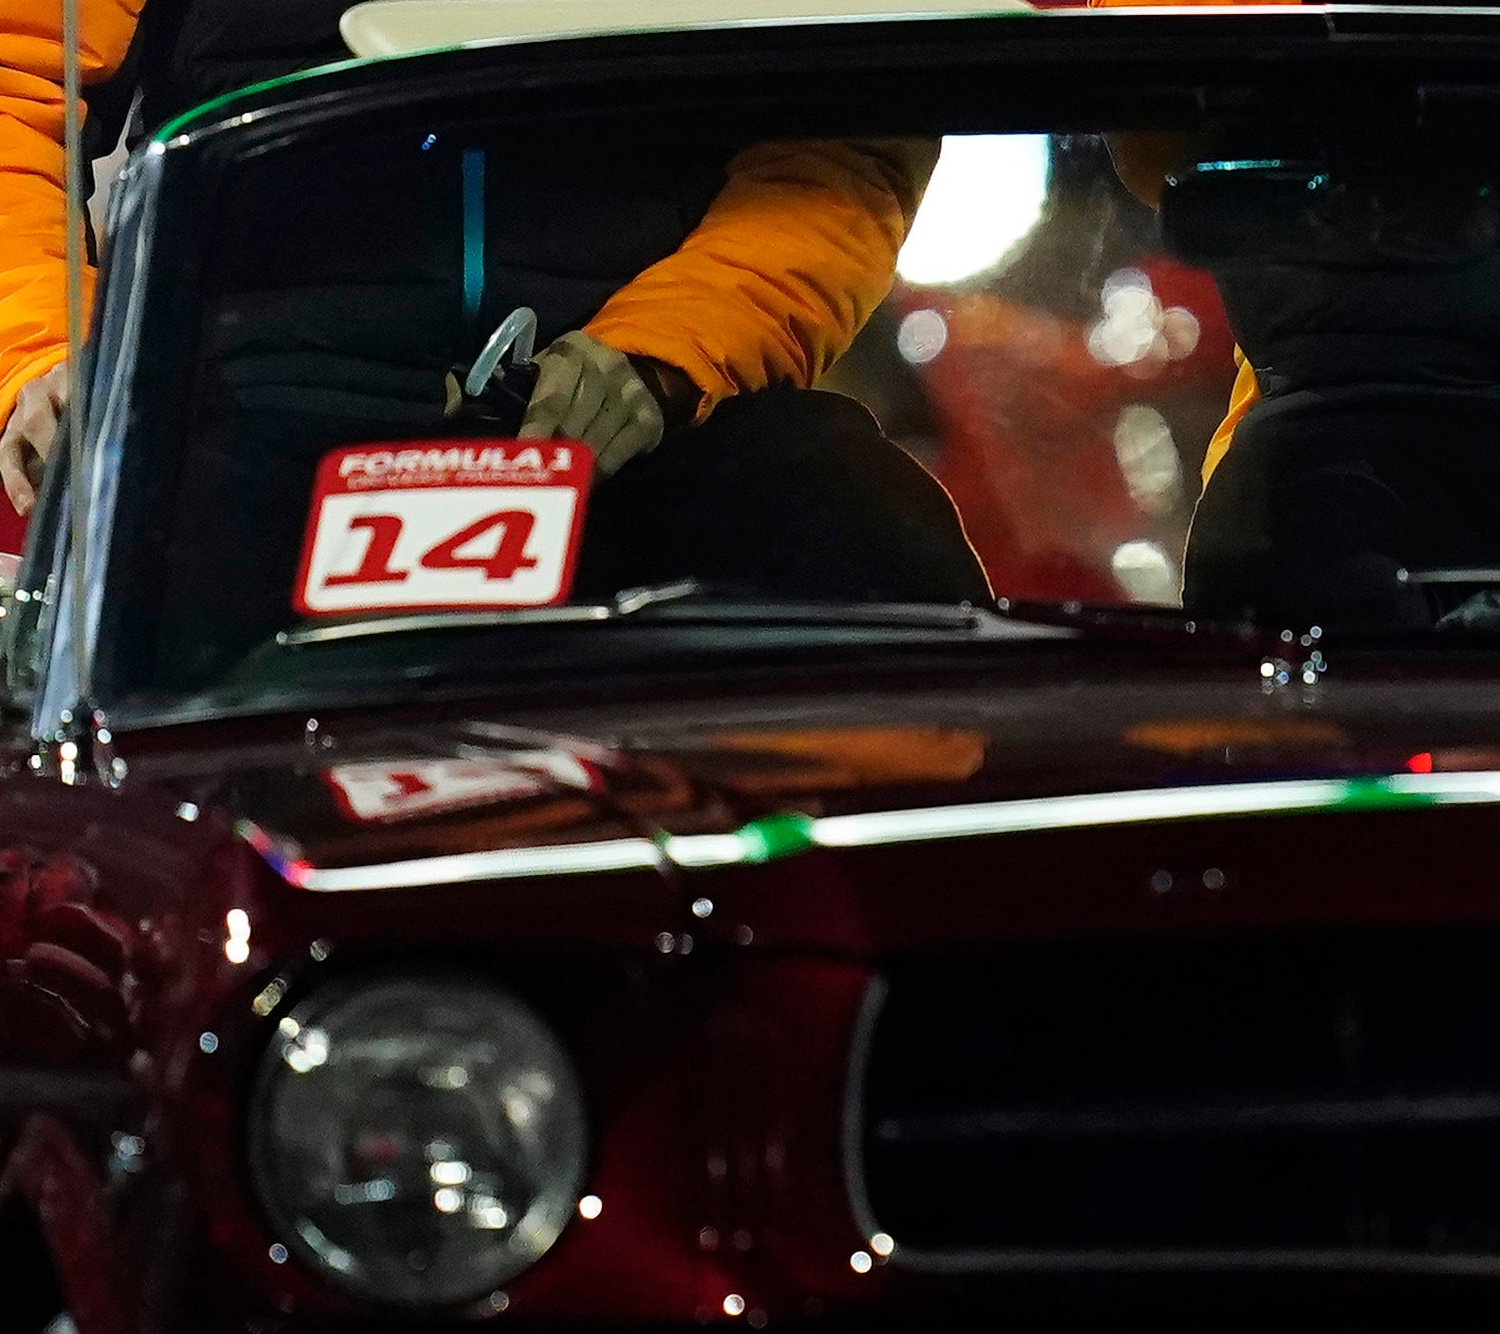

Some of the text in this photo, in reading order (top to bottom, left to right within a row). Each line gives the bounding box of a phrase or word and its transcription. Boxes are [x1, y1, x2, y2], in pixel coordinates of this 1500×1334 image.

[338, 447, 543, 478] FORMULA
[550, 447, 572, 472] 1
[324, 509, 539, 586] 14
